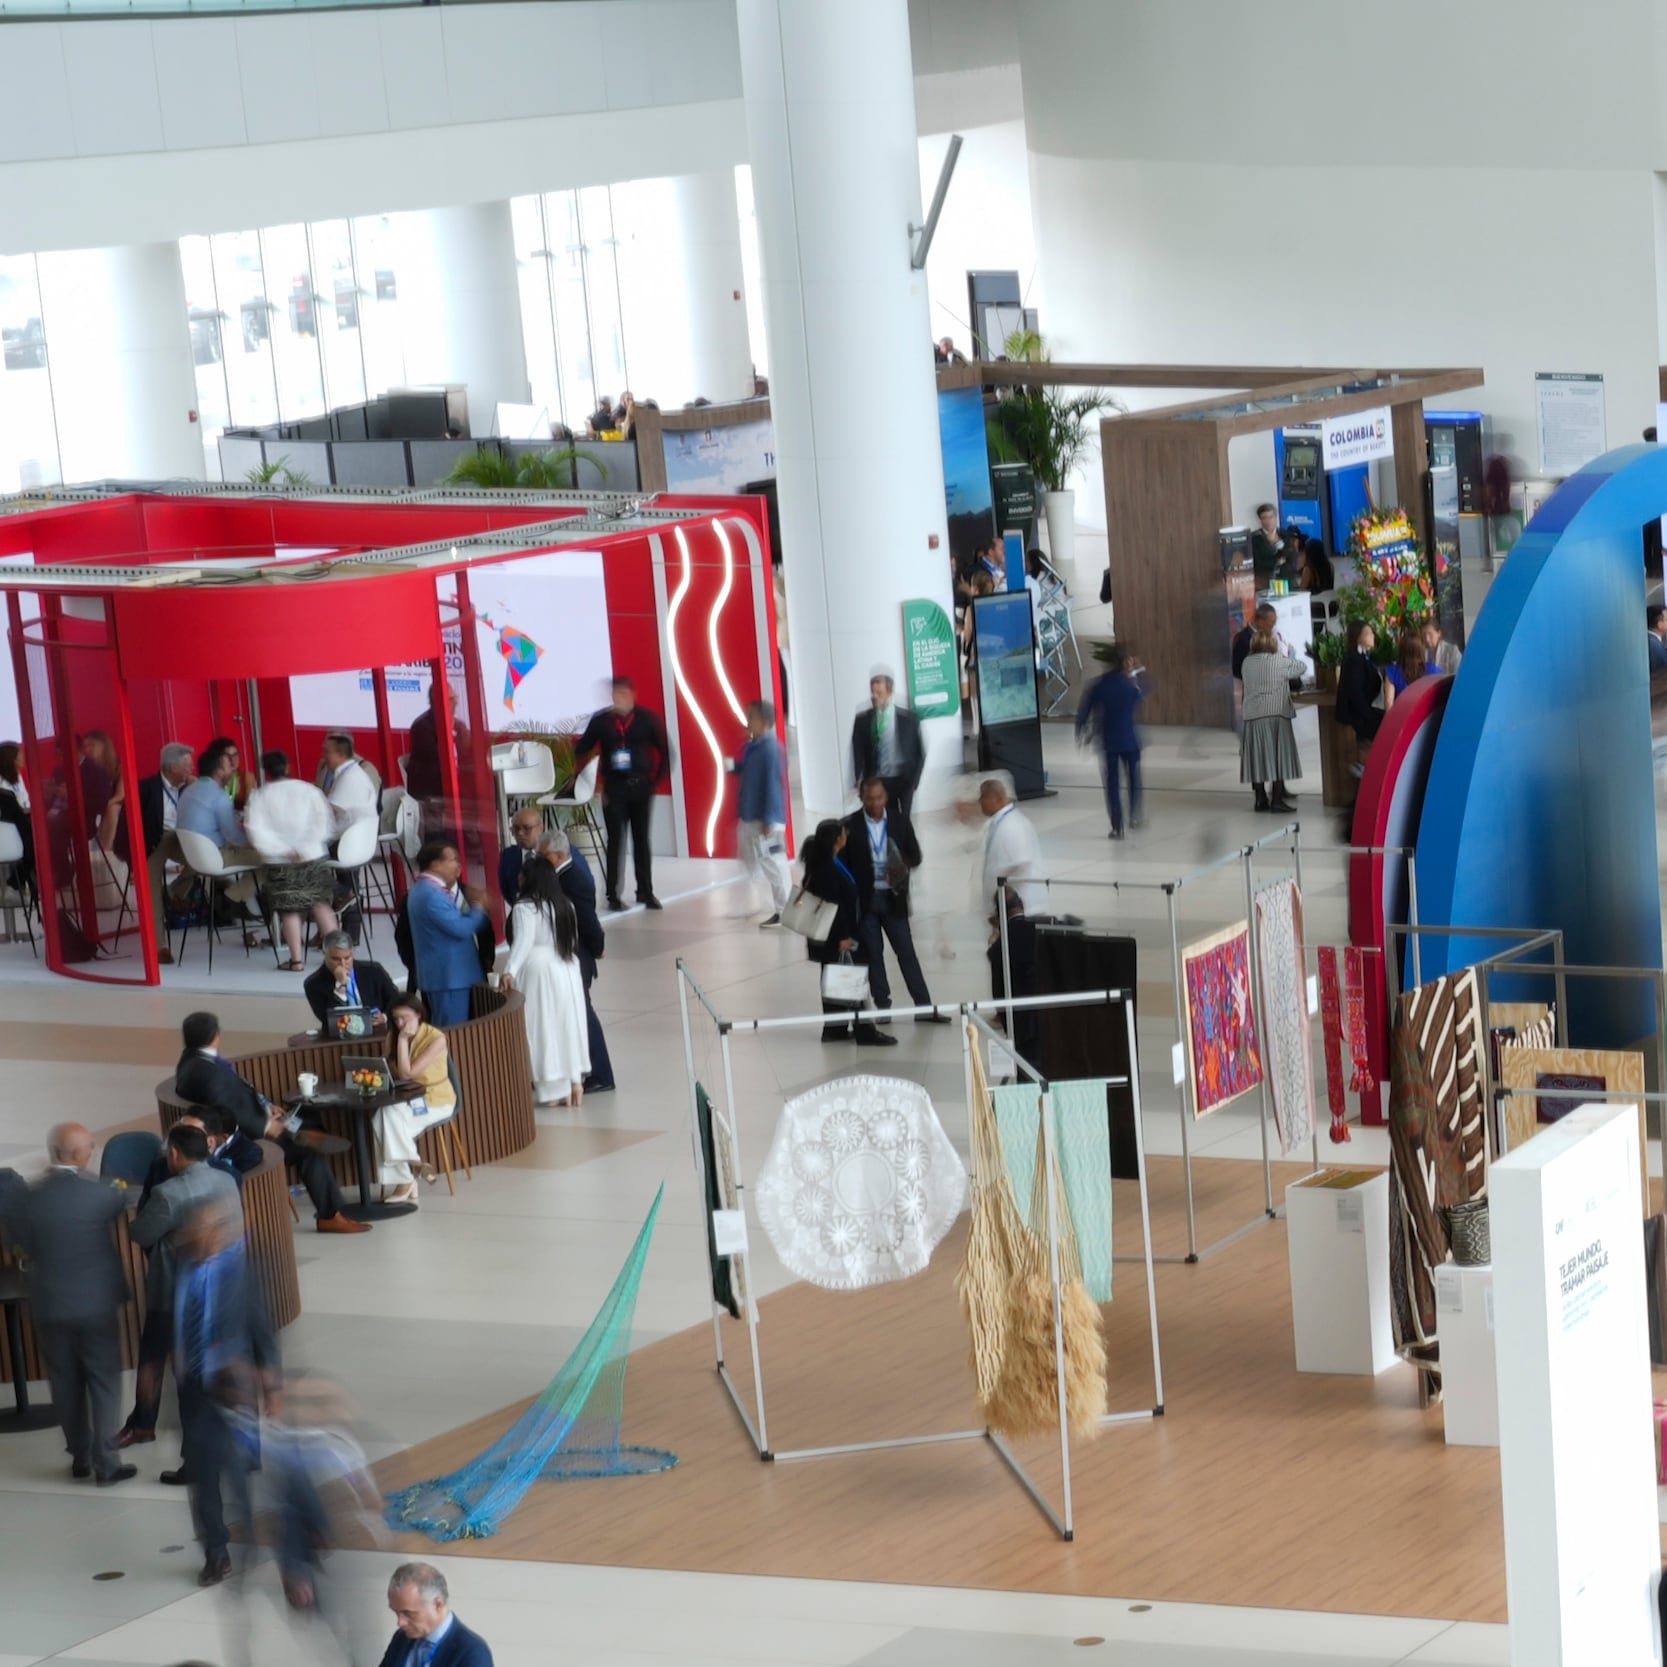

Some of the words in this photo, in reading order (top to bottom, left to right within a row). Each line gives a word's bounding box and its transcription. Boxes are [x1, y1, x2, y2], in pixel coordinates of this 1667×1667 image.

[1329, 423, 1375, 446] COLOMBIA
[1560, 1256, 1577, 1280] TEJER
[1560, 1267, 1586, 1297] TRAMAR
[1585, 1250, 1608, 1280] PAISAJE
